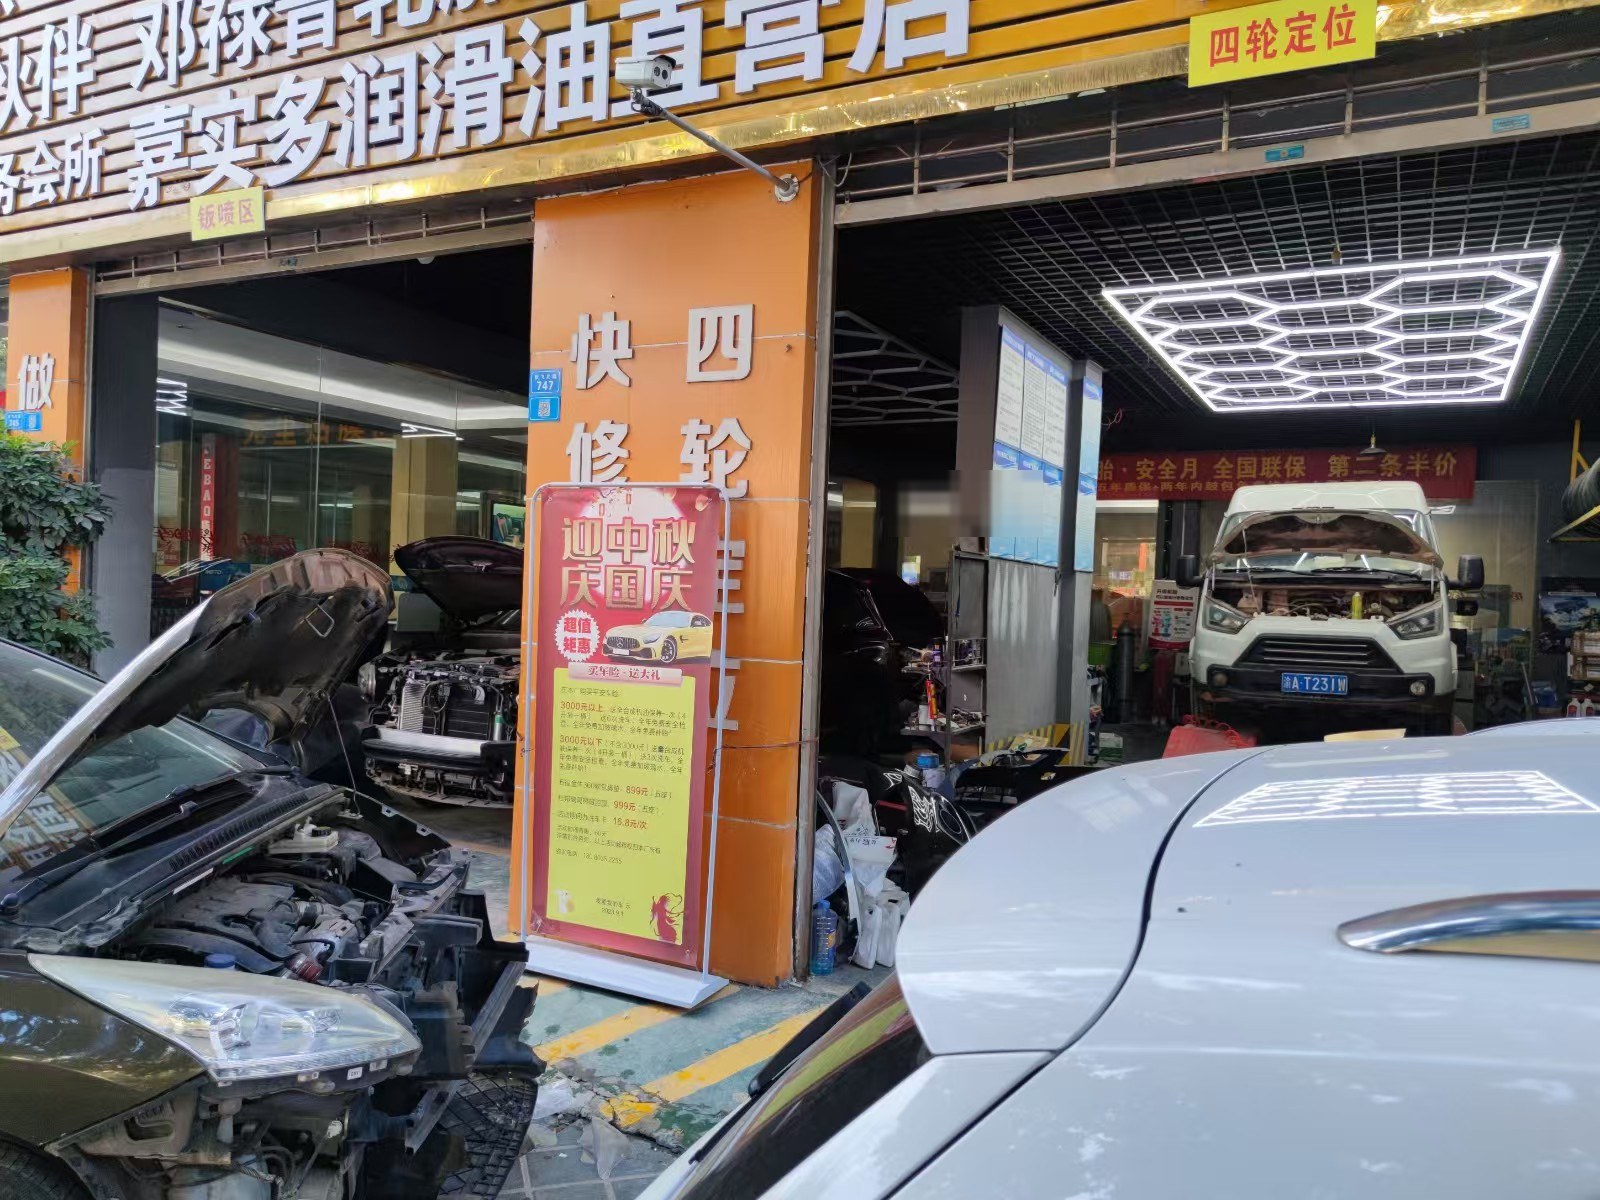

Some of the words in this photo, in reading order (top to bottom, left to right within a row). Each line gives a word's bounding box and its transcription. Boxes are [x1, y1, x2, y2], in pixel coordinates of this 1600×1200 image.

[1209, 3, 1357, 67] 四轮定位
[198, 199, 254, 230] 钣喷区
[18, 352, 56, 411] 做
[536, 380, 554, 391] 747
[1213, 455, 1306, 479] 全国联保
[1327, 453, 1457, 478] 第二条半价
[561, 517, 697, 564] 迎中秋
[559, 564, 694, 613] 庆国庆
[563, 617, 592, 633] 超值
[560, 701, 603, 713] 3000元以上
[559, 734, 603, 747] 3000元以下
[625, 785, 649, 797] 899元
[613, 801, 637, 812] 999元
